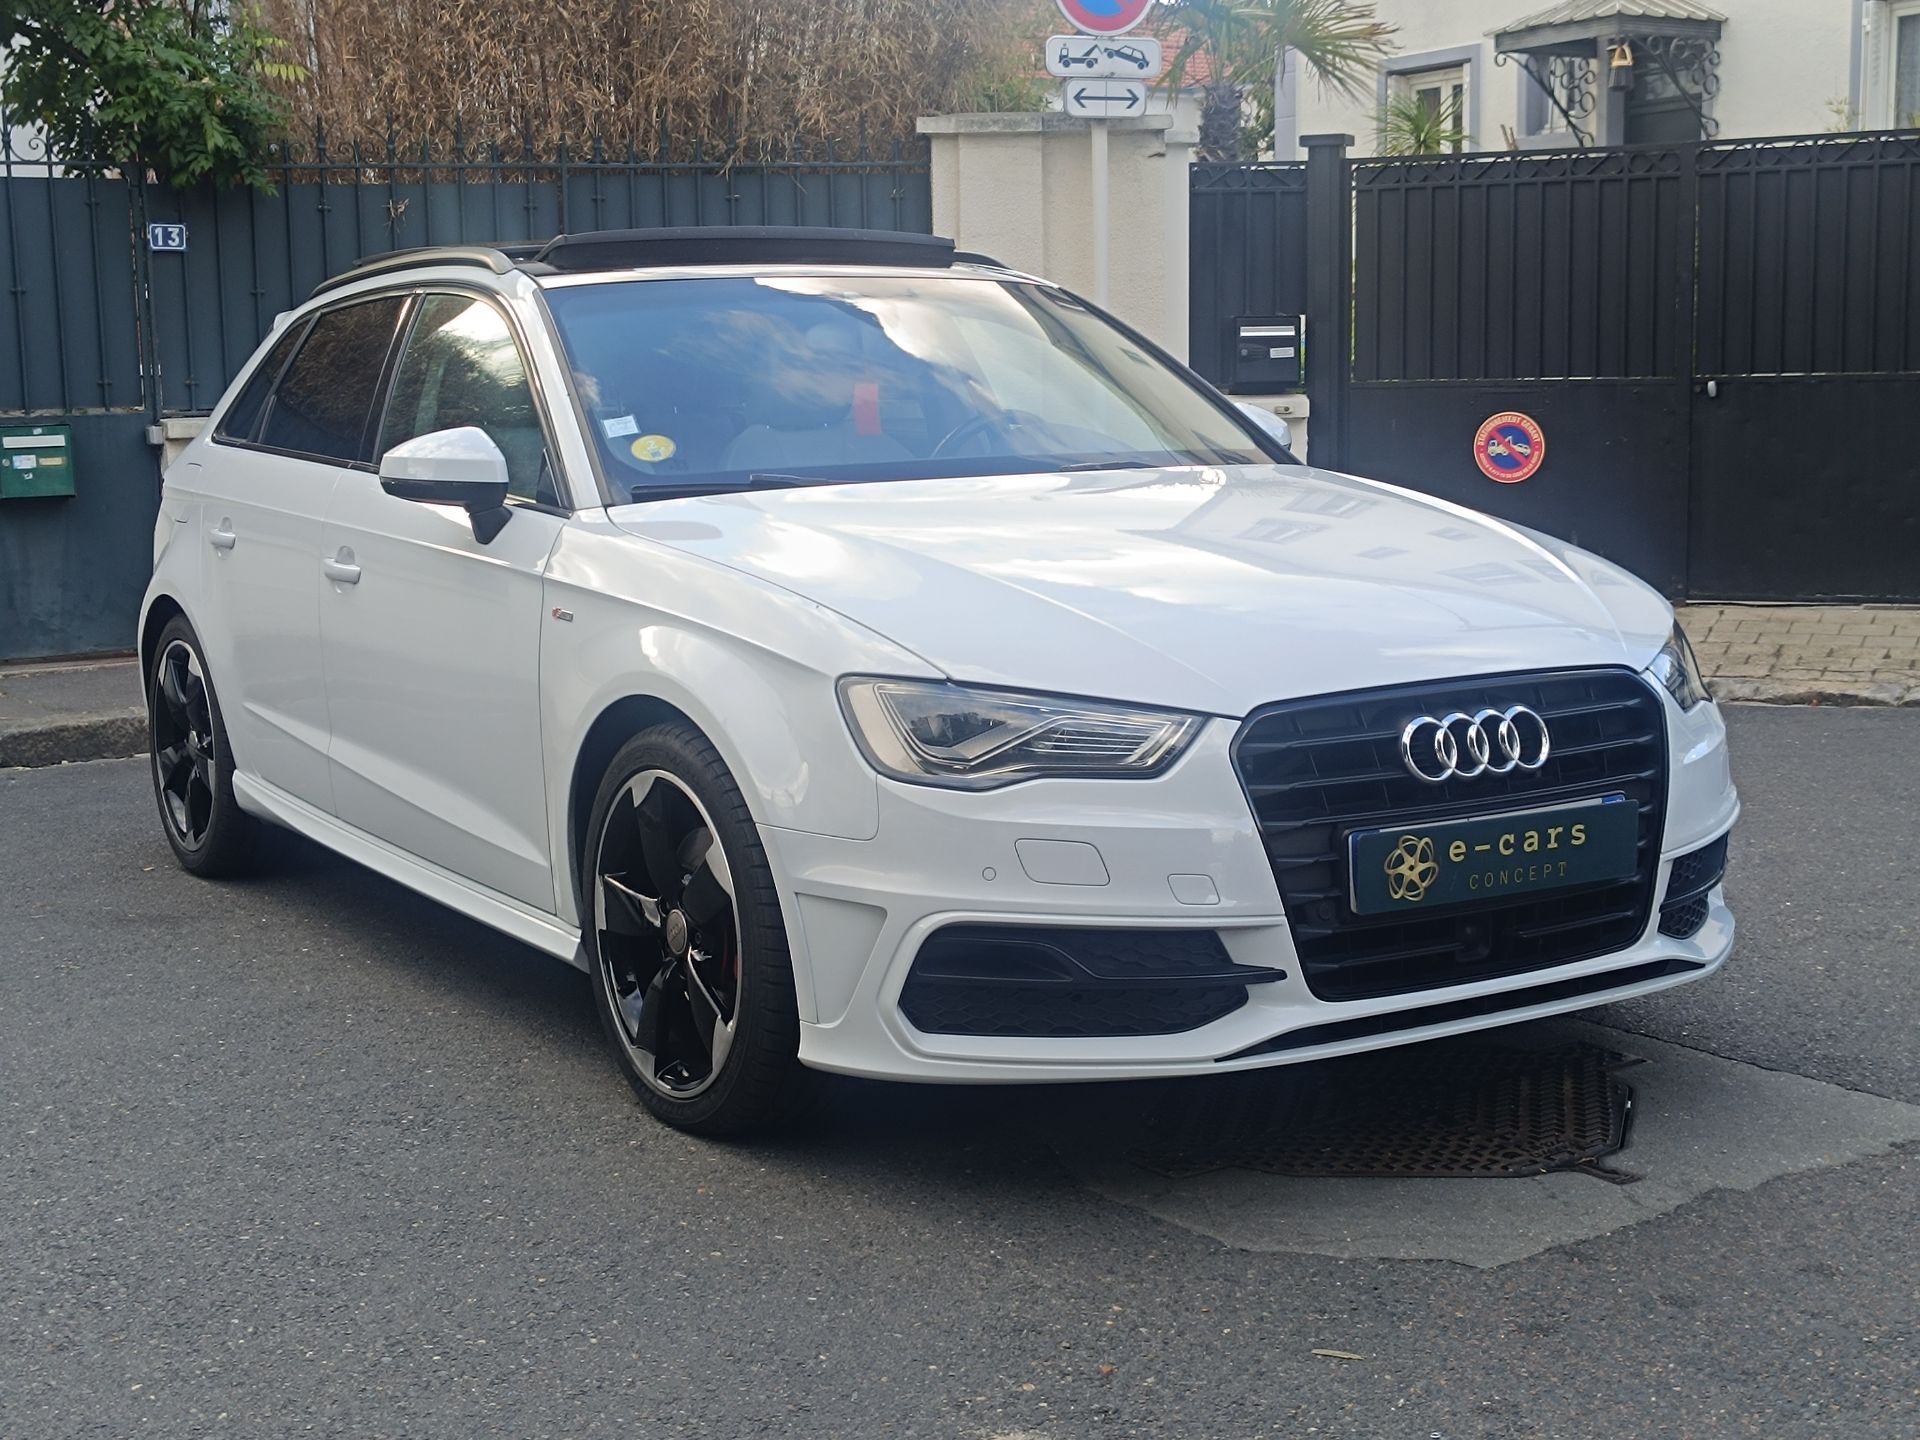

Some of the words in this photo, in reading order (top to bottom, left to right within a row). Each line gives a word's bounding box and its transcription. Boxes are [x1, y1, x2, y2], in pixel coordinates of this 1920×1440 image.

[155, 227, 180, 246] 13
[1449, 823, 1586, 862] e-cars
[1469, 862, 1567, 889] CONCEPT
